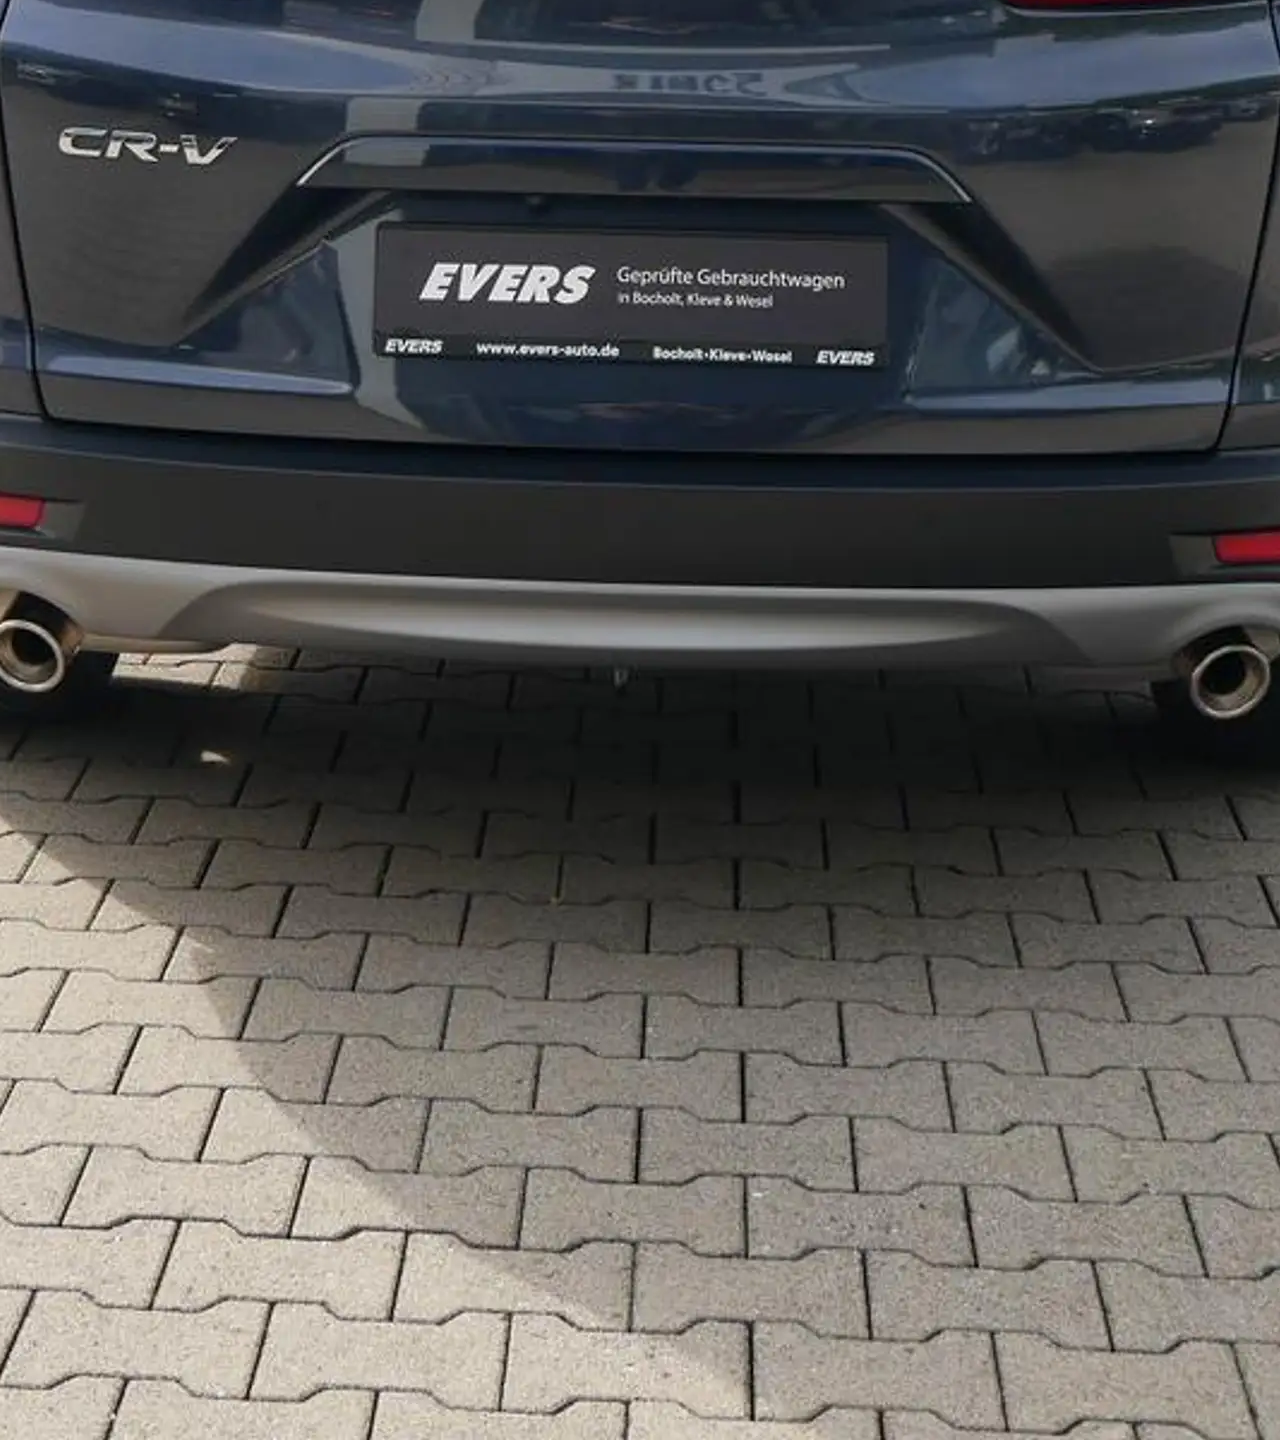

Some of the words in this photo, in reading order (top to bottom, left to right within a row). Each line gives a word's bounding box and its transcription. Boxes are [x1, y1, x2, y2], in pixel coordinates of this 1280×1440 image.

[58, 126, 239, 165] CR-V
[419, 262, 596, 304] EVERS
[617, 266, 694, 287] Geprüfte
[697, 268, 846, 292] Gebrauchtwagen
[617, 292, 630, 305] in
[632, 291, 685, 307] Bocholt,
[687, 293, 721, 307] Kleve
[723, 294, 734, 307] &
[736, 294, 774, 308] Wesel
[385, 338, 444, 354] EVERS
[476, 341, 620, 357] www.evers-auto.de
[816, 349, 875, 366] EVERS
